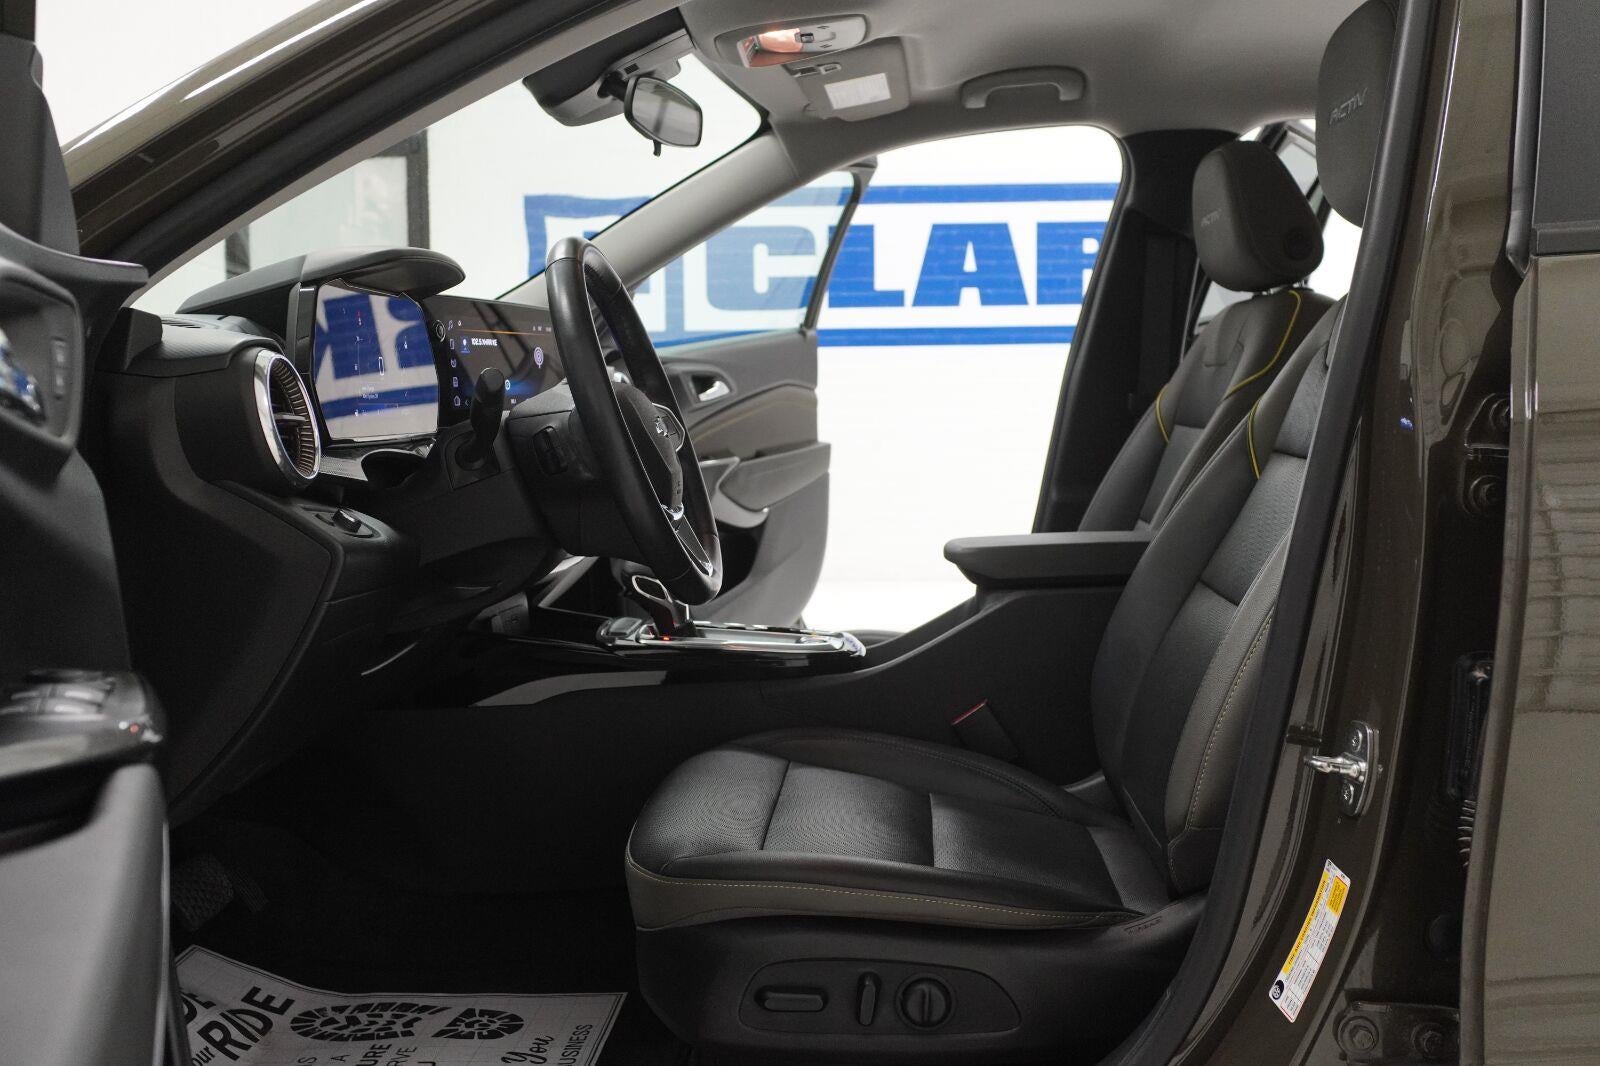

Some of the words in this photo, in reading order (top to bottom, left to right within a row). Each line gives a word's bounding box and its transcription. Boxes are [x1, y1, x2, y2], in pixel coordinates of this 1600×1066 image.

[196, 985, 296, 1061] RIDE
[355, 1043, 393, 1066] URE
[557, 1024, 594, 1066] USINESS
